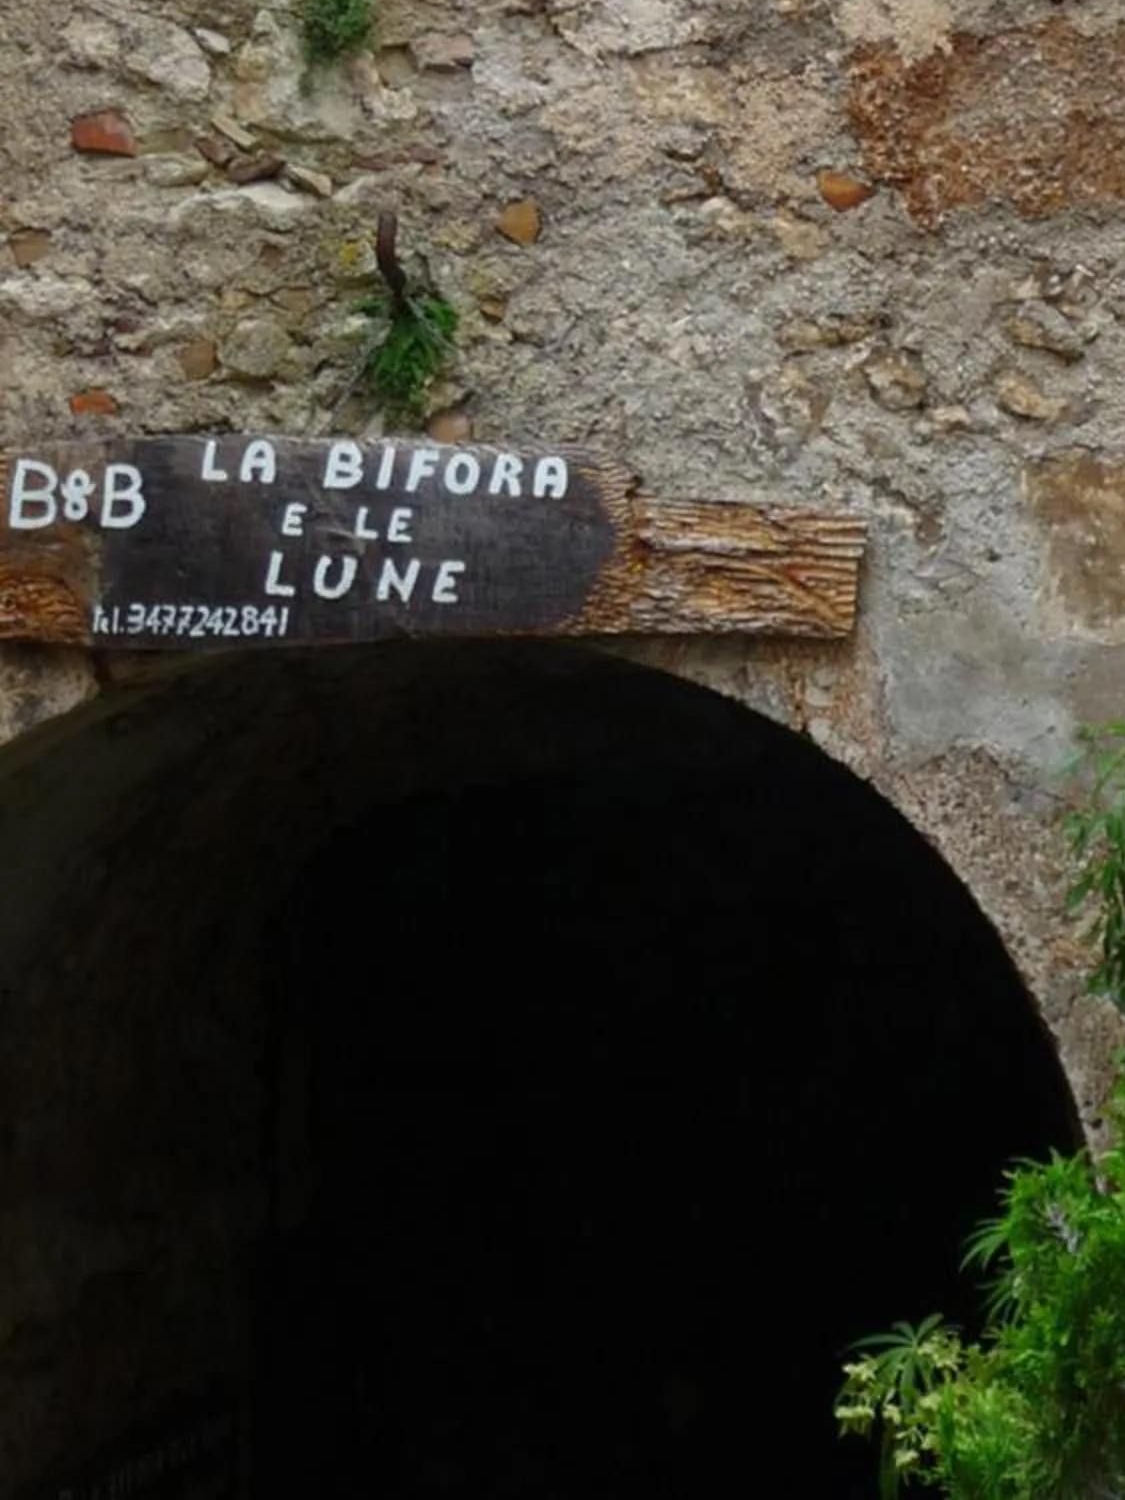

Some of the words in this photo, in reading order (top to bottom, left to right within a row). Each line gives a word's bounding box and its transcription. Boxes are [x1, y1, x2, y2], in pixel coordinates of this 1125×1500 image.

[9, 459, 146, 529] B&B
[202, 439, 276, 484] LA
[323, 440, 568, 499] BIFORA
[281, 503, 307, 536] E
[355, 507, 413, 542] LE
[265, 551, 465, 603] LUNE
